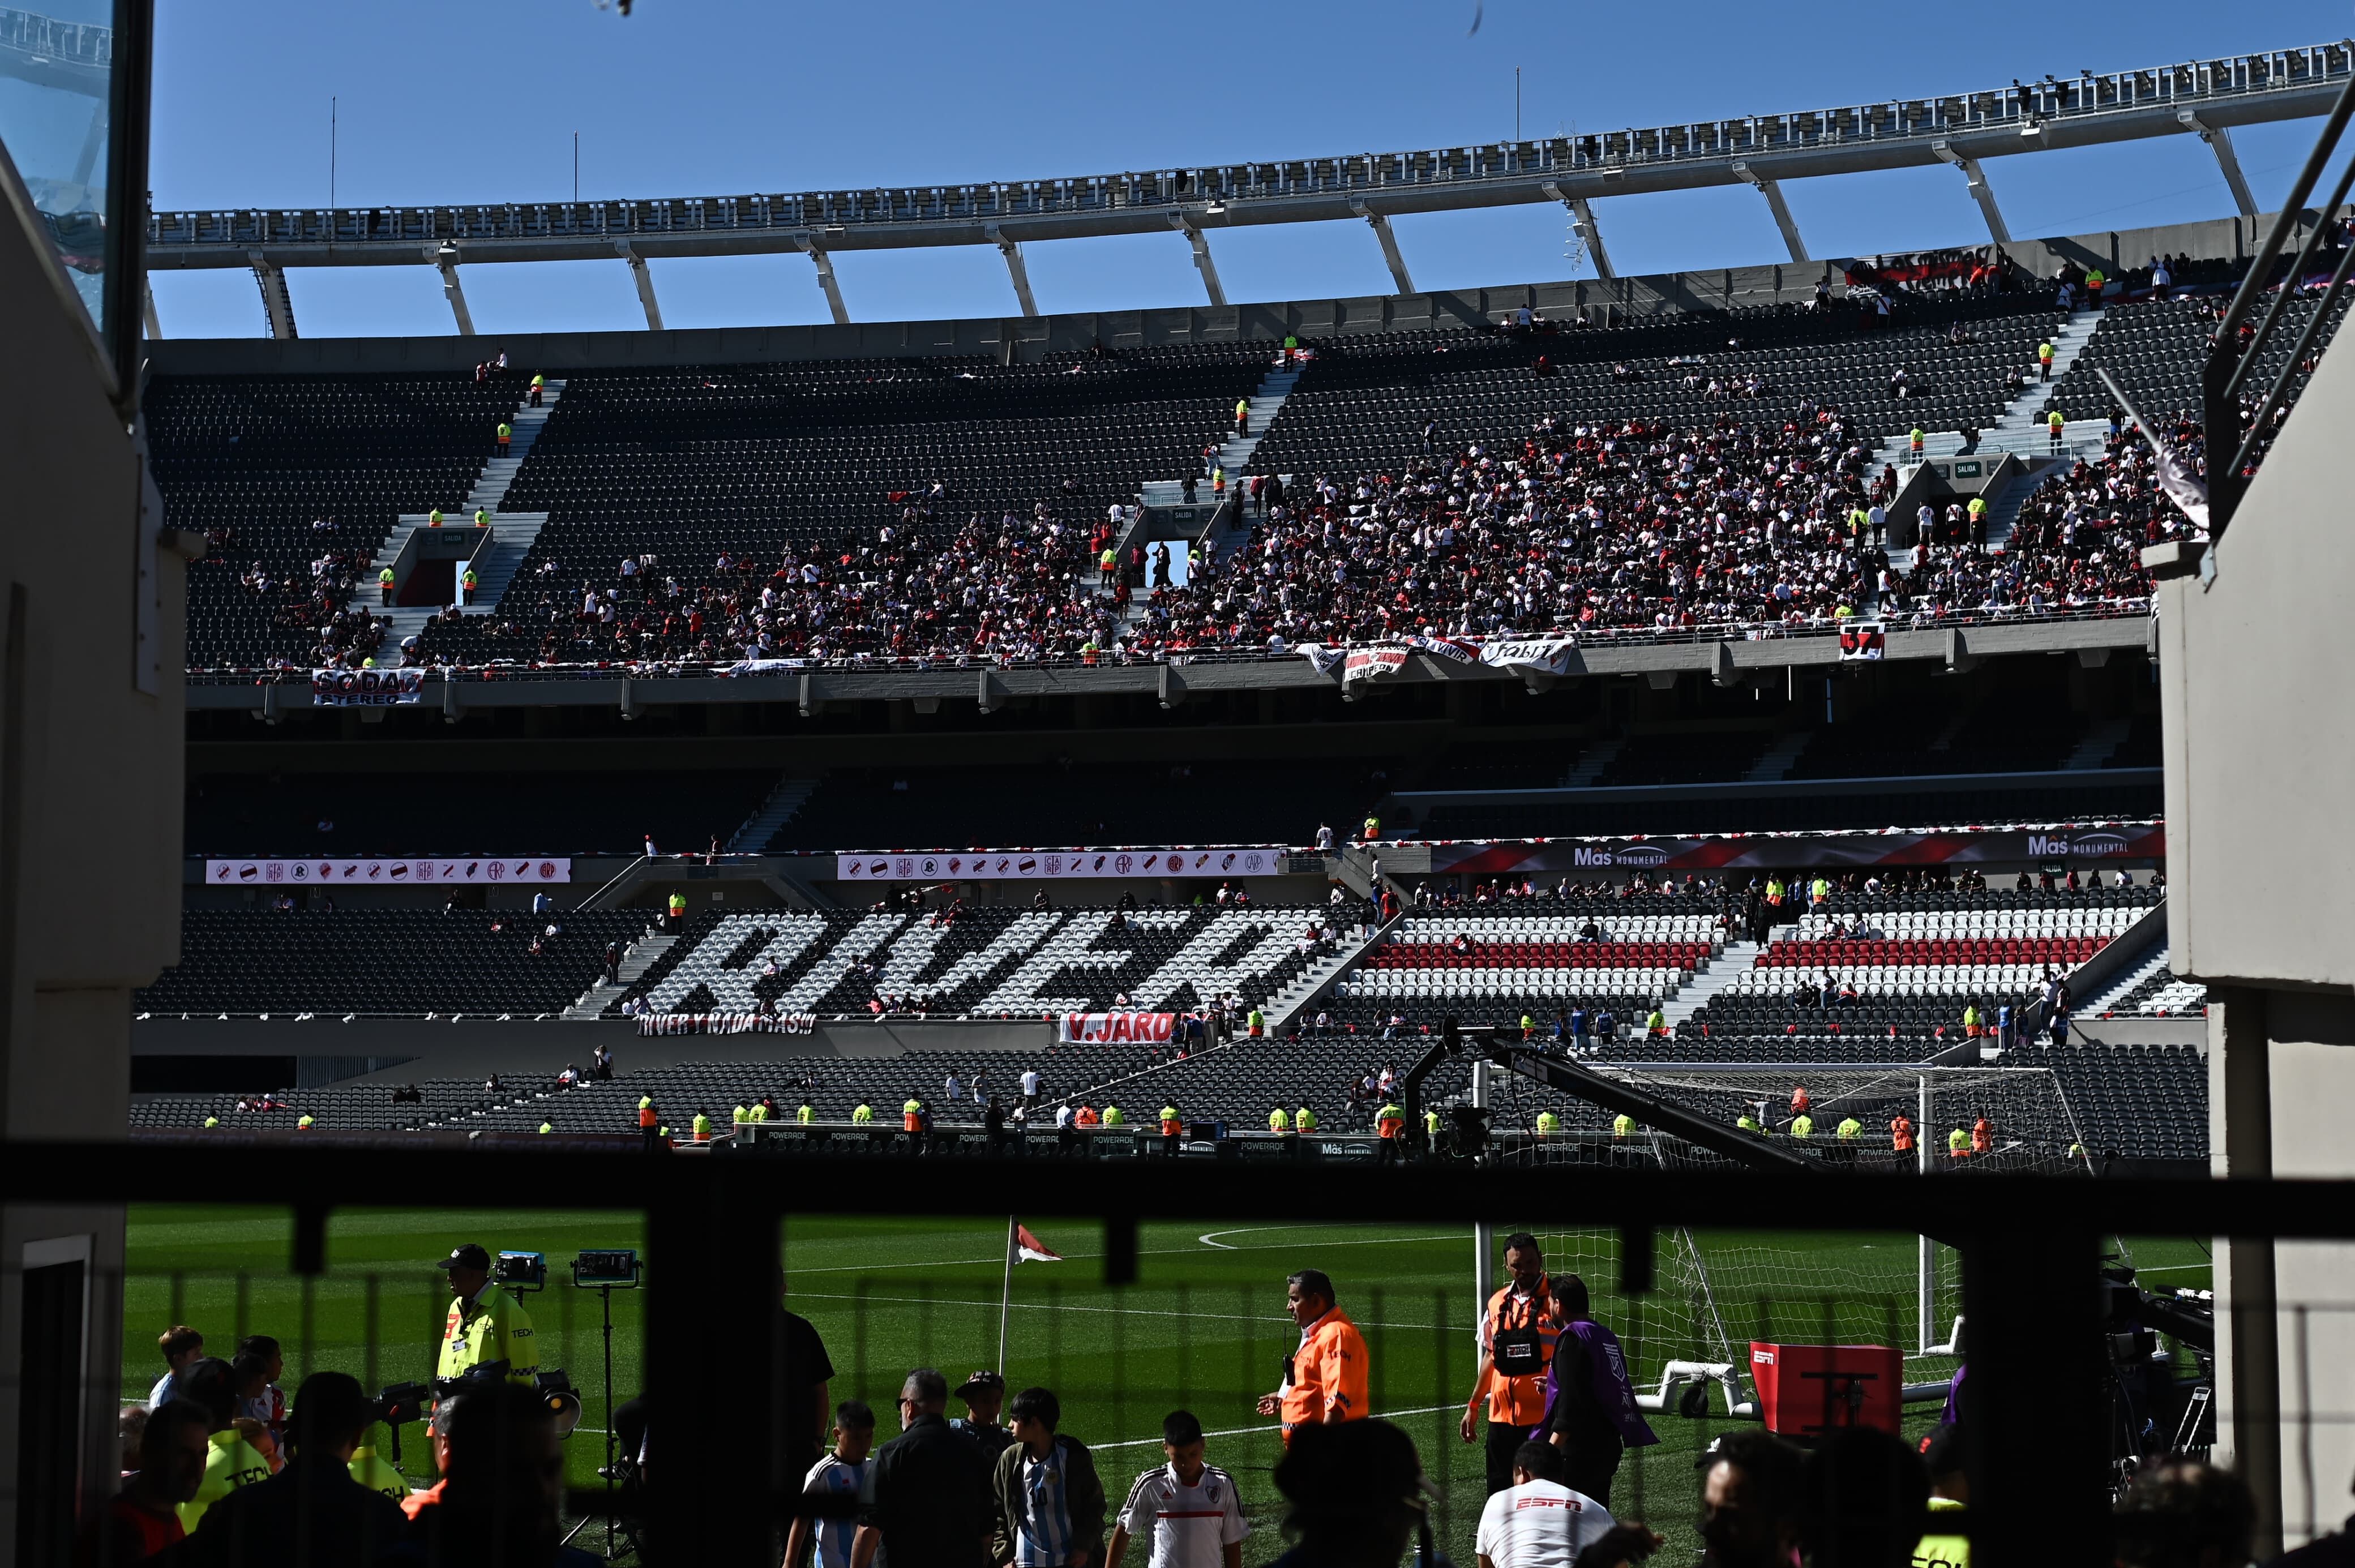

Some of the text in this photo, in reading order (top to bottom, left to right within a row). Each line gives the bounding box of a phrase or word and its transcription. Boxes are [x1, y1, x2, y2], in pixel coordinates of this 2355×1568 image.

[1958, 465, 1976, 473] SALIDA
[1843, 626, 1879, 655] 37
[1437, 642, 1468, 662] VIVIR
[1351, 664, 1394, 679] CAMPEON
[316, 671, 401, 693] SODA
[321, 694, 399, 705] STEREO
[2073, 843, 2129, 854] MONUMENTAL
[1616, 855, 1667, 865] MONUMENTAL
[2041, 864, 2062, 873] SALIDA
[645, 912, 1325, 1015] RIVER
[638, 1013, 689, 1035] RIVER
[693, 1013, 705, 1034] Y
[707, 1013, 756, 1035] NADA
[1241, 1142, 1286, 1150] POWERADE
[1537, 1143, 1579, 1152] OWERADE
[511, 1328, 533, 1338] TECH
[1328, 1349, 1351, 1362] TECH
[1753, 1350, 1775, 1365] ESPN
[1029, 1486, 1048, 1507] 10
[1516, 1497, 1582, 1513] ESPN
